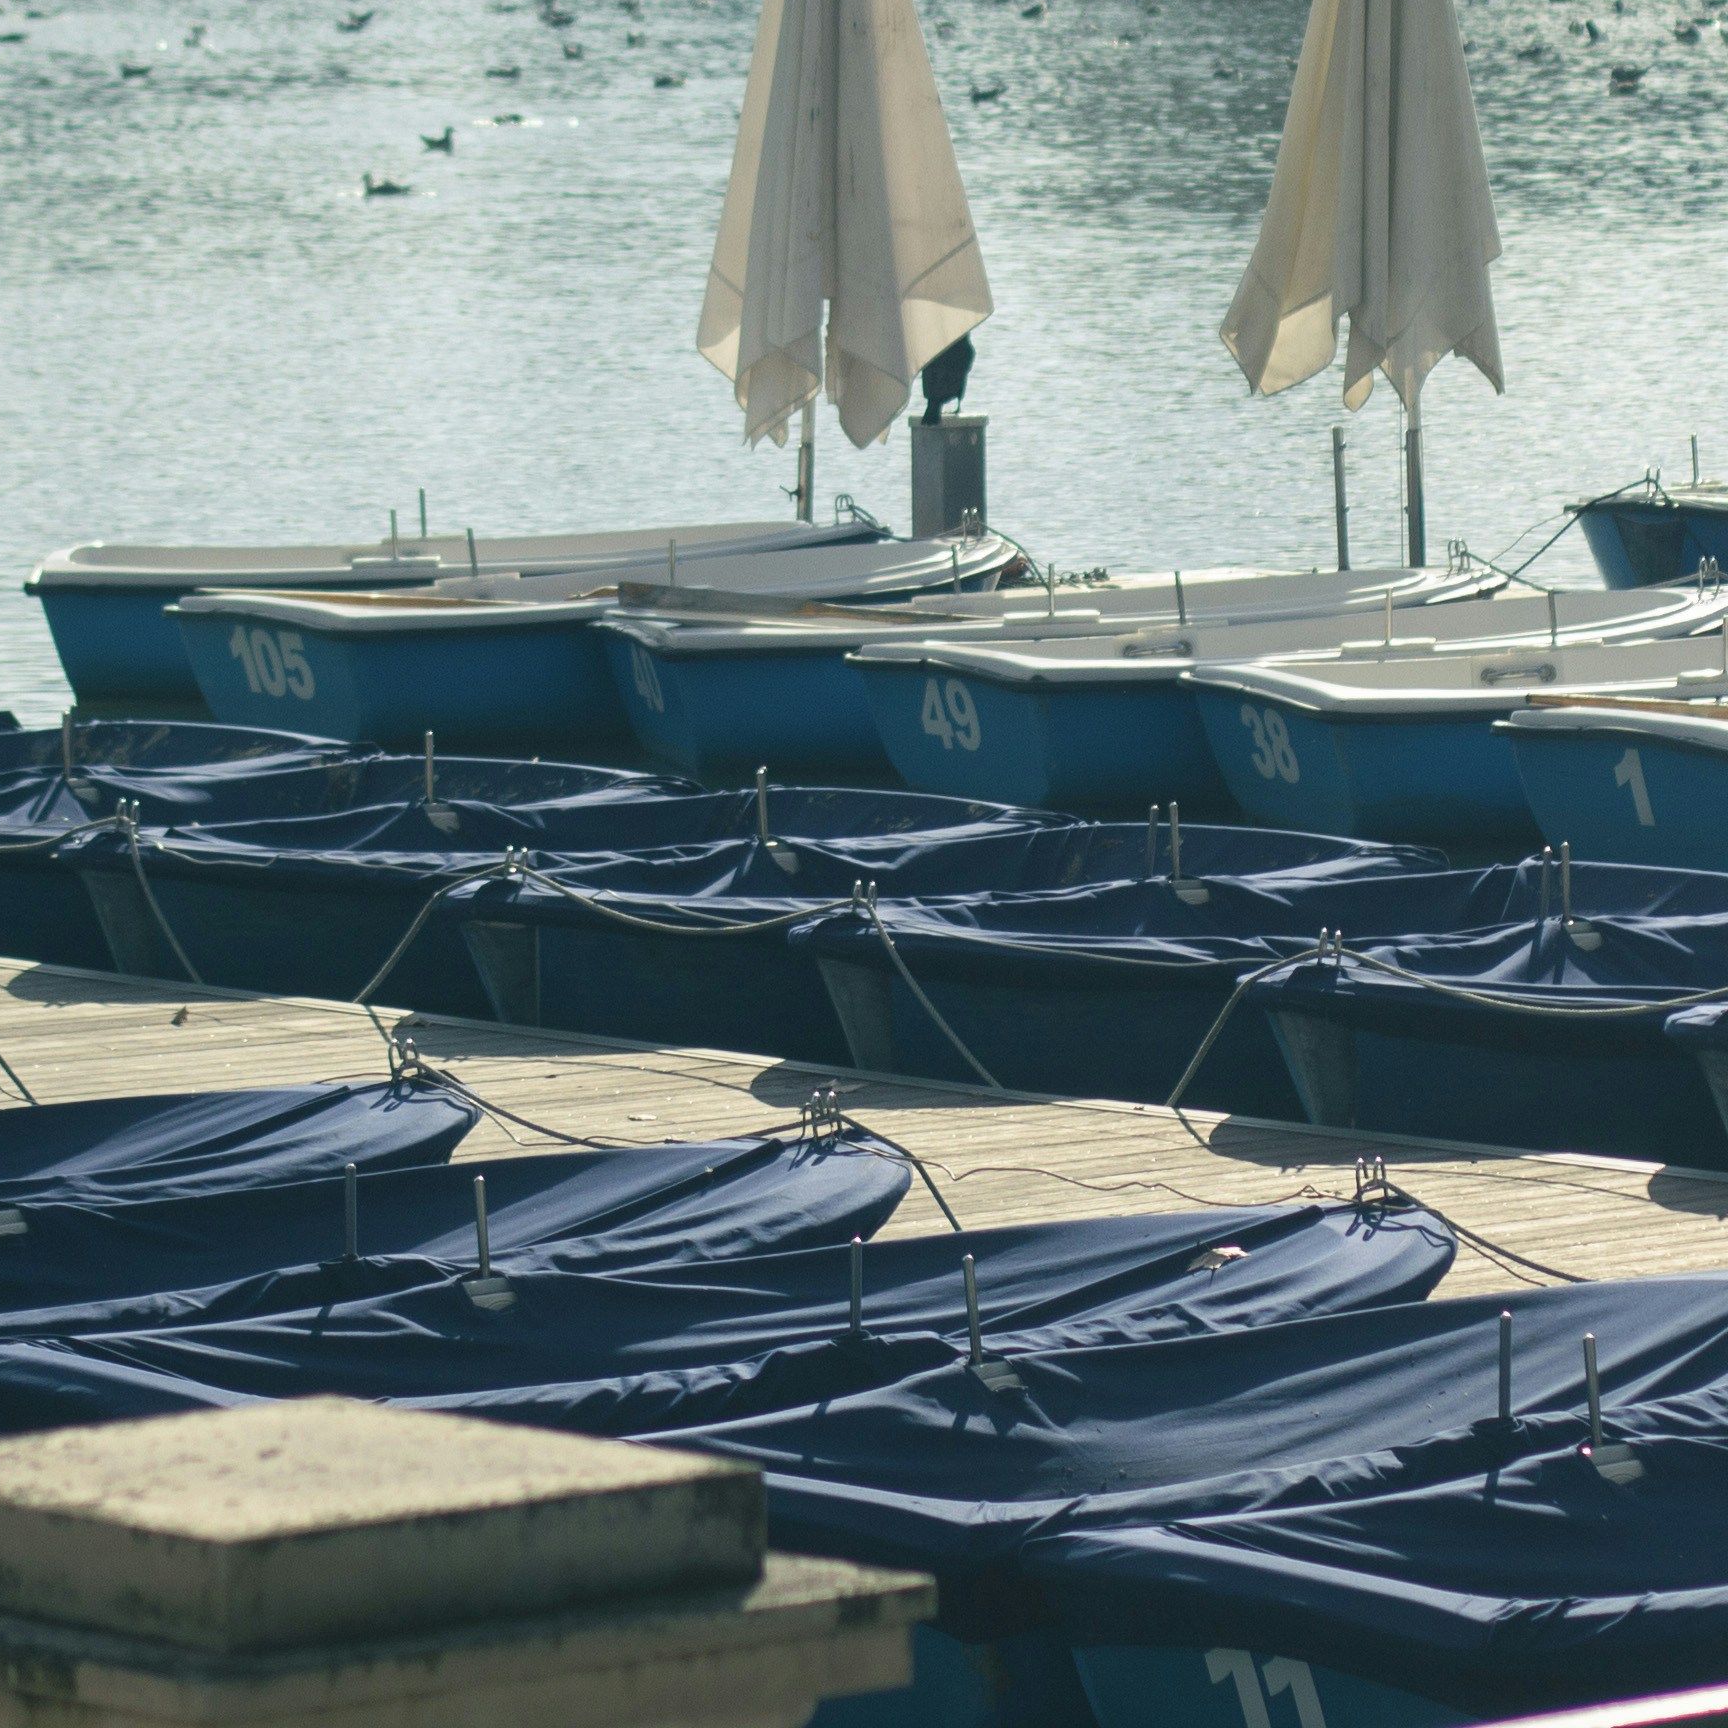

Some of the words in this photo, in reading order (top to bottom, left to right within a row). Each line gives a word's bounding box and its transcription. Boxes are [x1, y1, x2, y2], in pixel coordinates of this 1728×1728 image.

[229, 624, 315, 700] 105
[922, 678, 981, 751] 49
[1241, 703, 1300, 784] 38
[1613, 748, 1656, 826] 1
[1204, 1647, 1327, 1728] 11
